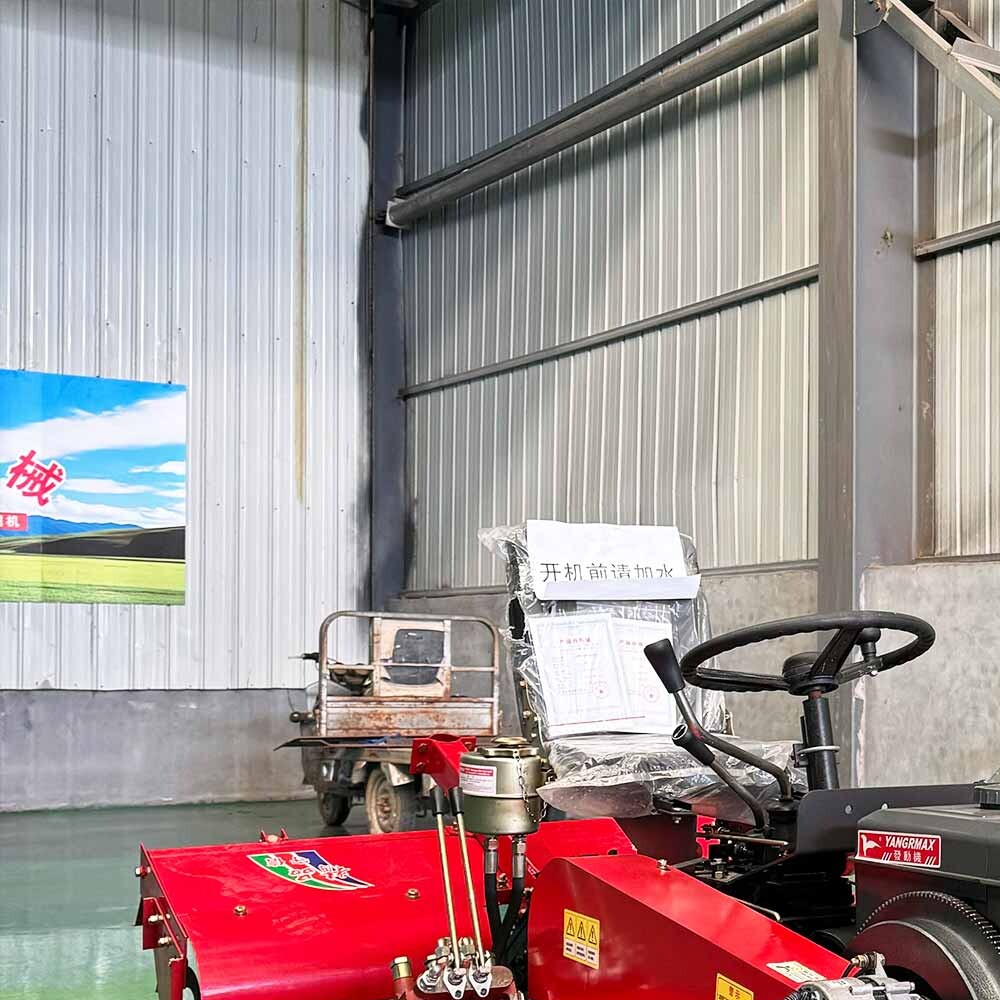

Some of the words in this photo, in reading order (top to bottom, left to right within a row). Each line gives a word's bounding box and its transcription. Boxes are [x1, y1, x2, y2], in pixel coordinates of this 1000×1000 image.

[6, 450, 65, 507] 械
[0, 514, 20, 528] 机
[540, 562, 674, 582] 开机前请加水
[885, 836, 936, 851] YANGRMAX
